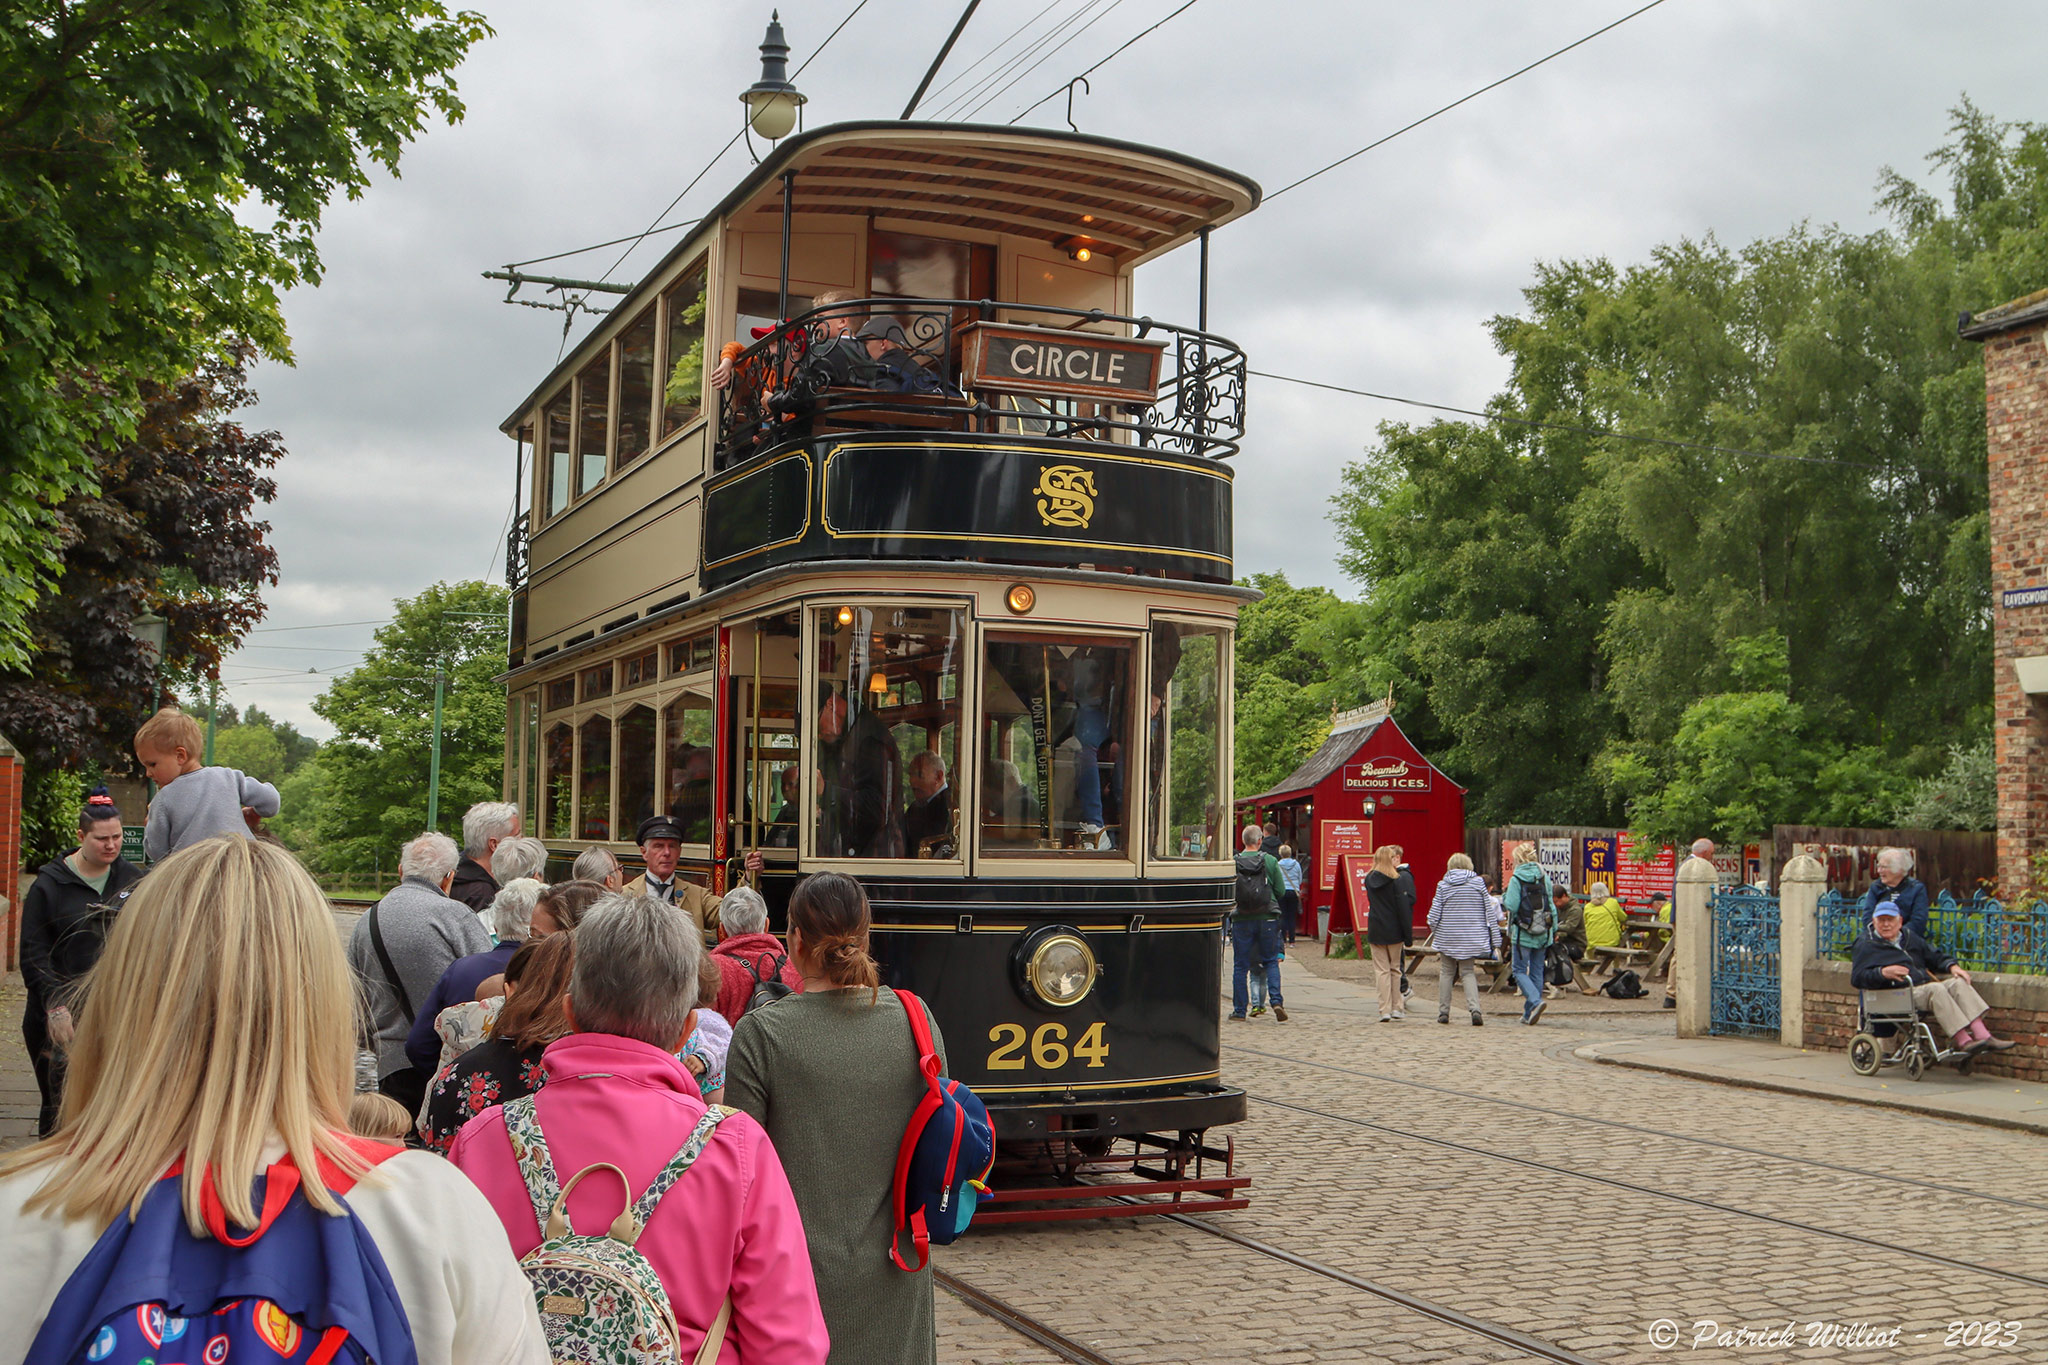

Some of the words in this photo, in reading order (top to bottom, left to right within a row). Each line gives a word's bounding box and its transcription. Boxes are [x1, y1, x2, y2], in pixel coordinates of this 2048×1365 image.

[1010, 343, 1126, 384] CIRCLE
[1035, 728, 1047, 747] GET
[1037, 756, 1048, 775] OFF
[1361, 761, 1409, 778] Beamish
[1346, 778, 1389, 787] DELICIOUS
[1392, 778, 1428, 788] ICES.
[1587, 840, 1609, 851] SMOKE
[1540, 849, 1570, 866] COLMAN'S
[1543, 868, 1569, 884] ARCH
[987, 1022, 1110, 1070] 264
